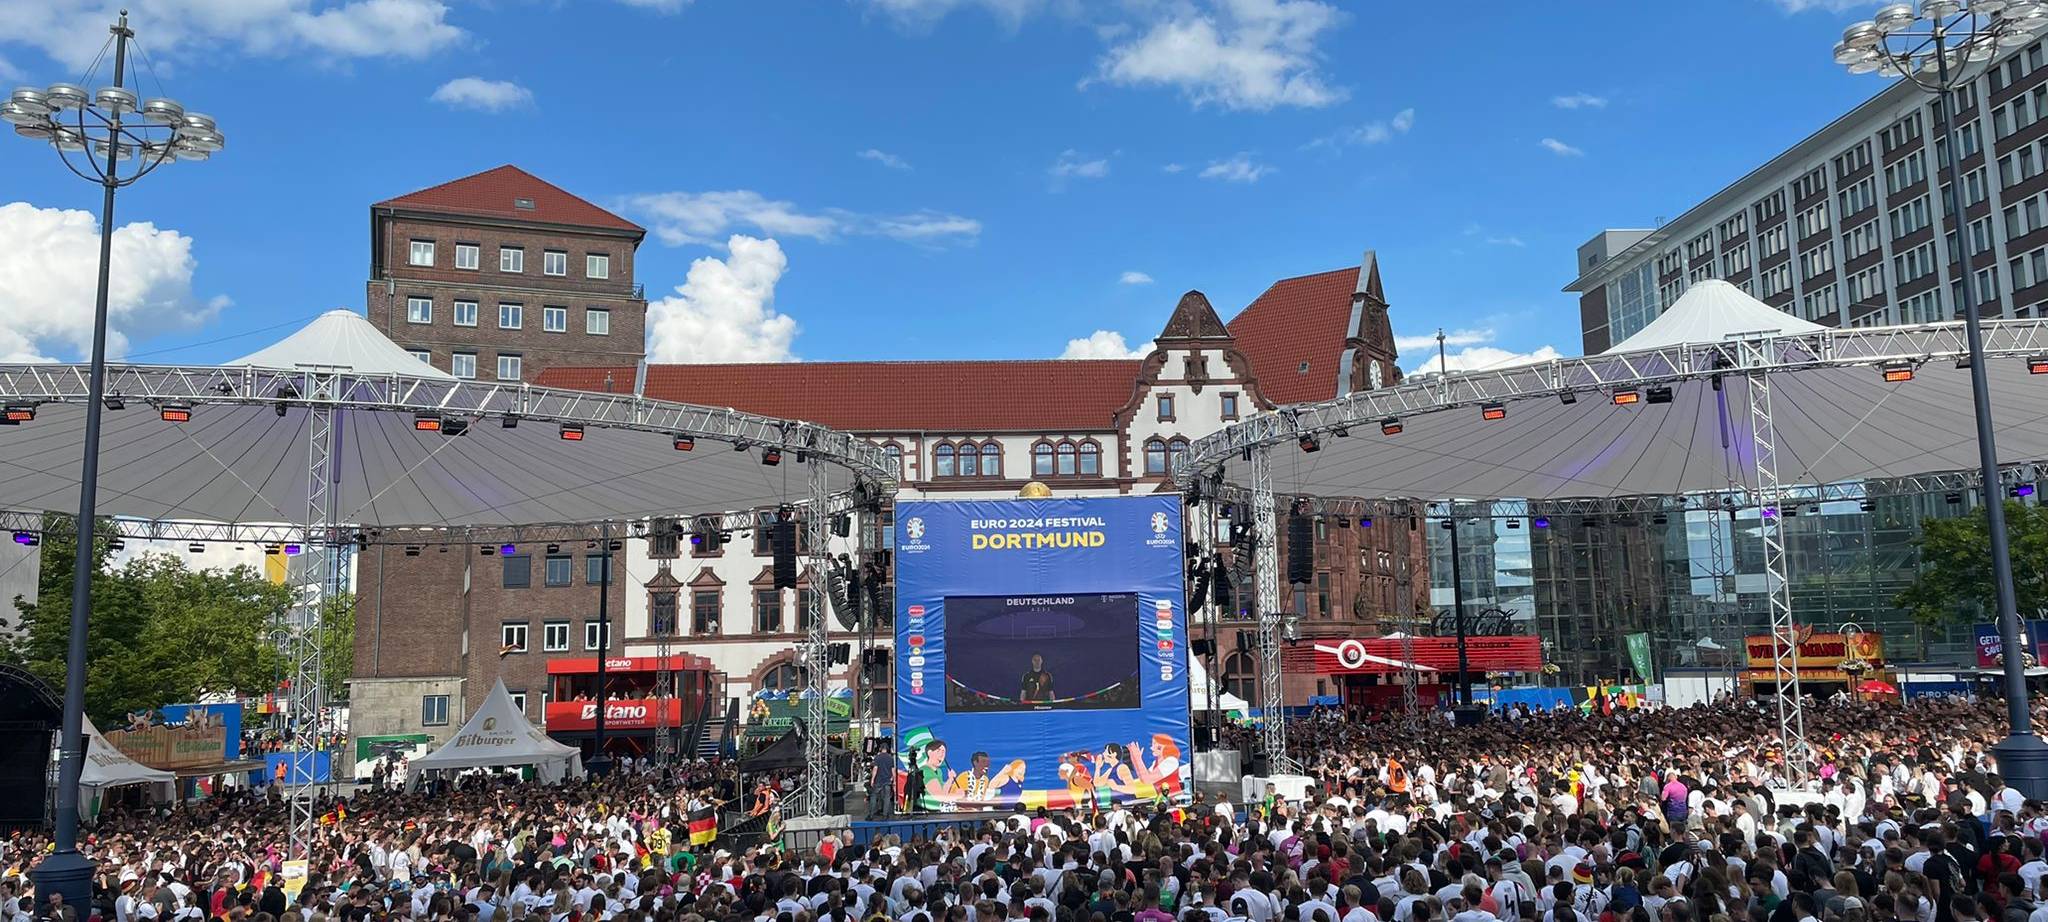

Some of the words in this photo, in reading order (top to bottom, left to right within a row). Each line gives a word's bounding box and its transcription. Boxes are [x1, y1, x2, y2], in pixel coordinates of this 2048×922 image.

[971, 519, 1007, 530] EURO
[1009, 518, 1043, 528] 2024
[1045, 517, 1106, 528] FESTIVAL
[972, 531, 1106, 550] DORTMUND
[1006, 597, 1075, 606] DEUTSCHLAND
[1800, 642, 1846, 658] MANN
[581, 704, 647, 720] Btano
[455, 733, 517, 748] Bitburger
